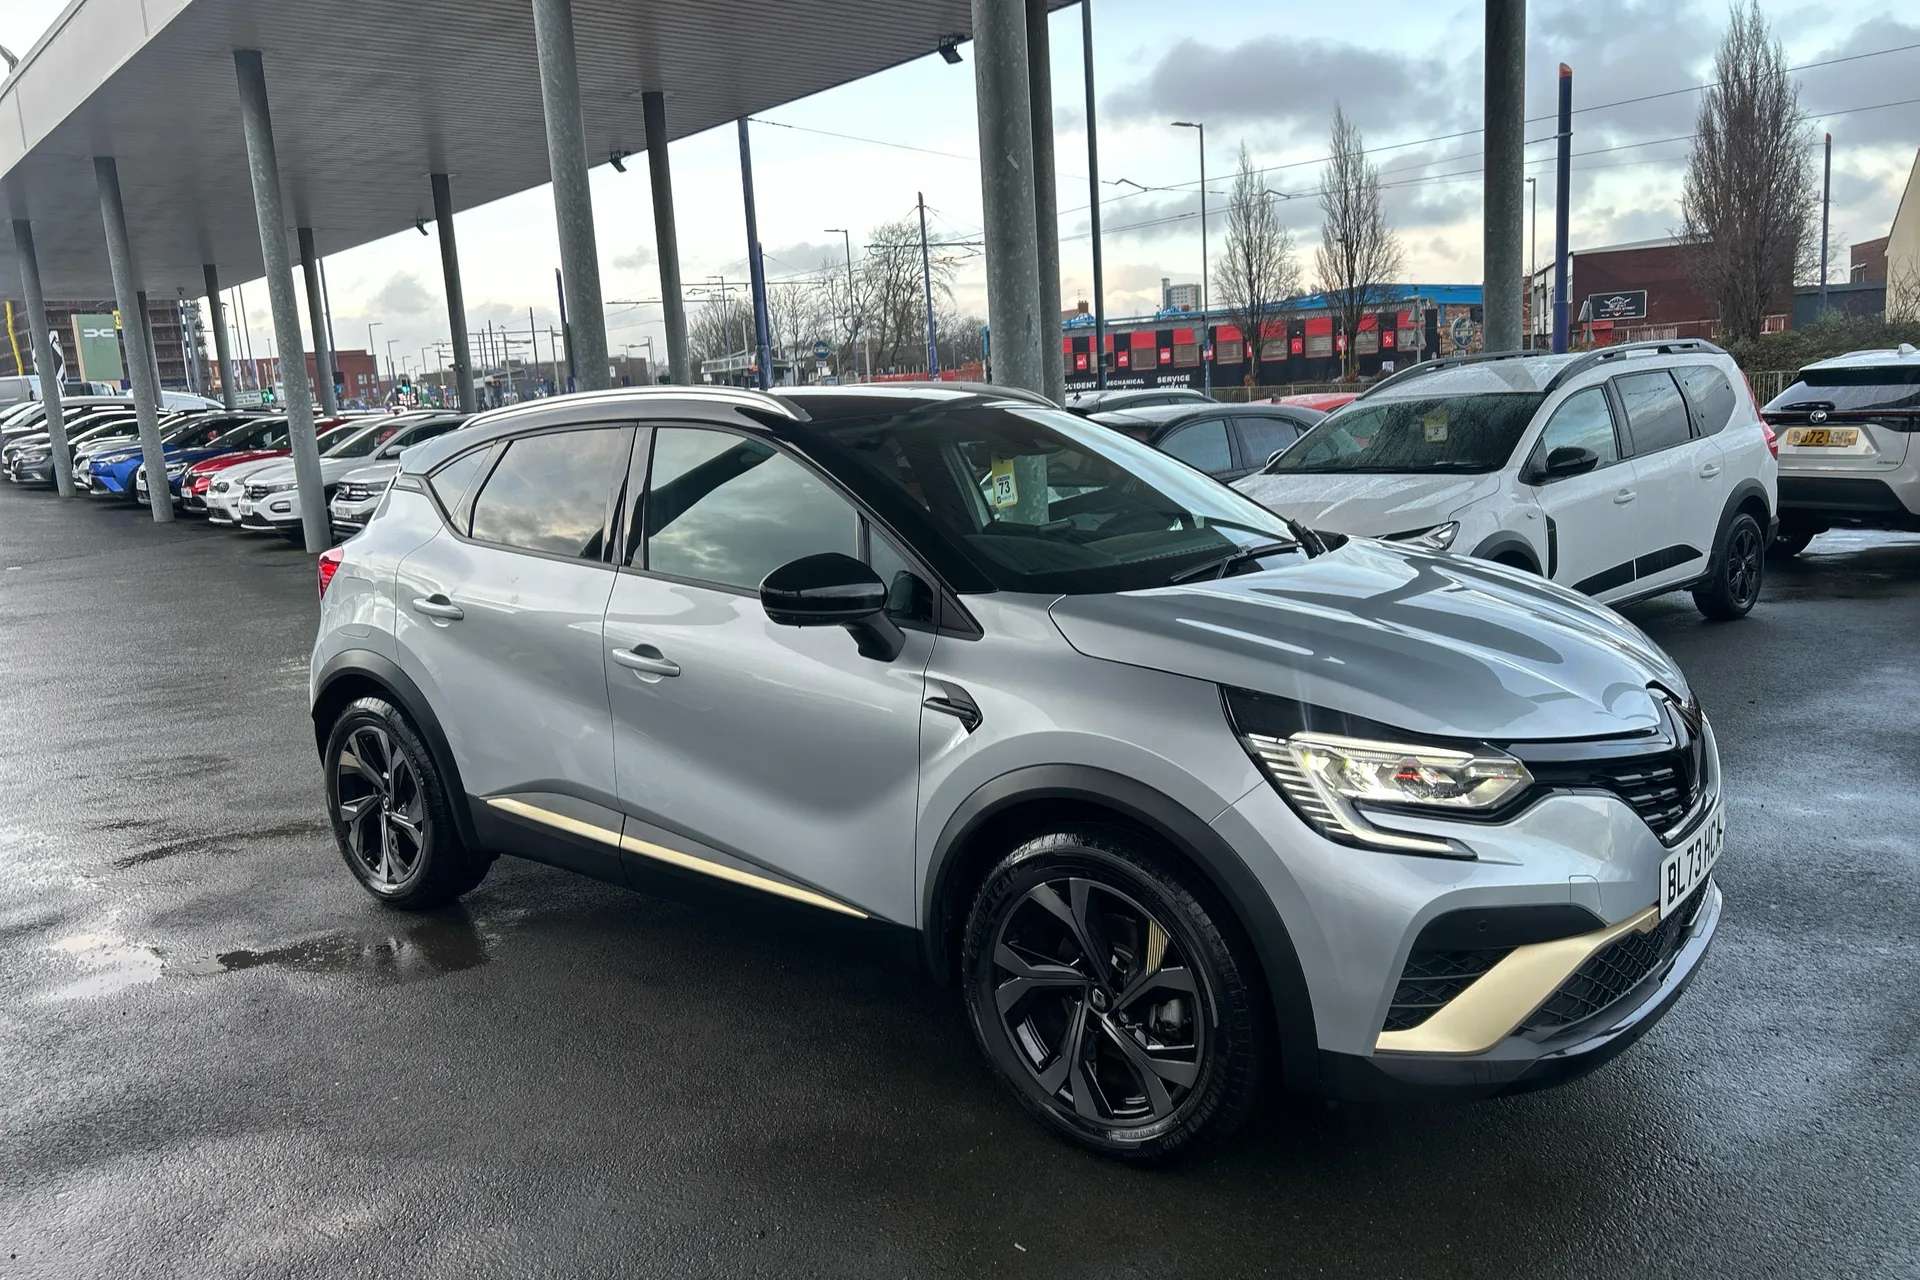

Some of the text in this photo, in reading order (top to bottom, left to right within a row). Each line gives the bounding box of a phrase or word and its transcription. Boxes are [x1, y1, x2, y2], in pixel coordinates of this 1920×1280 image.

[1157, 374, 1190, 384] SERVICE
[999, 481, 1011, 495] 73
[1667, 838, 1701, 905] BL73
